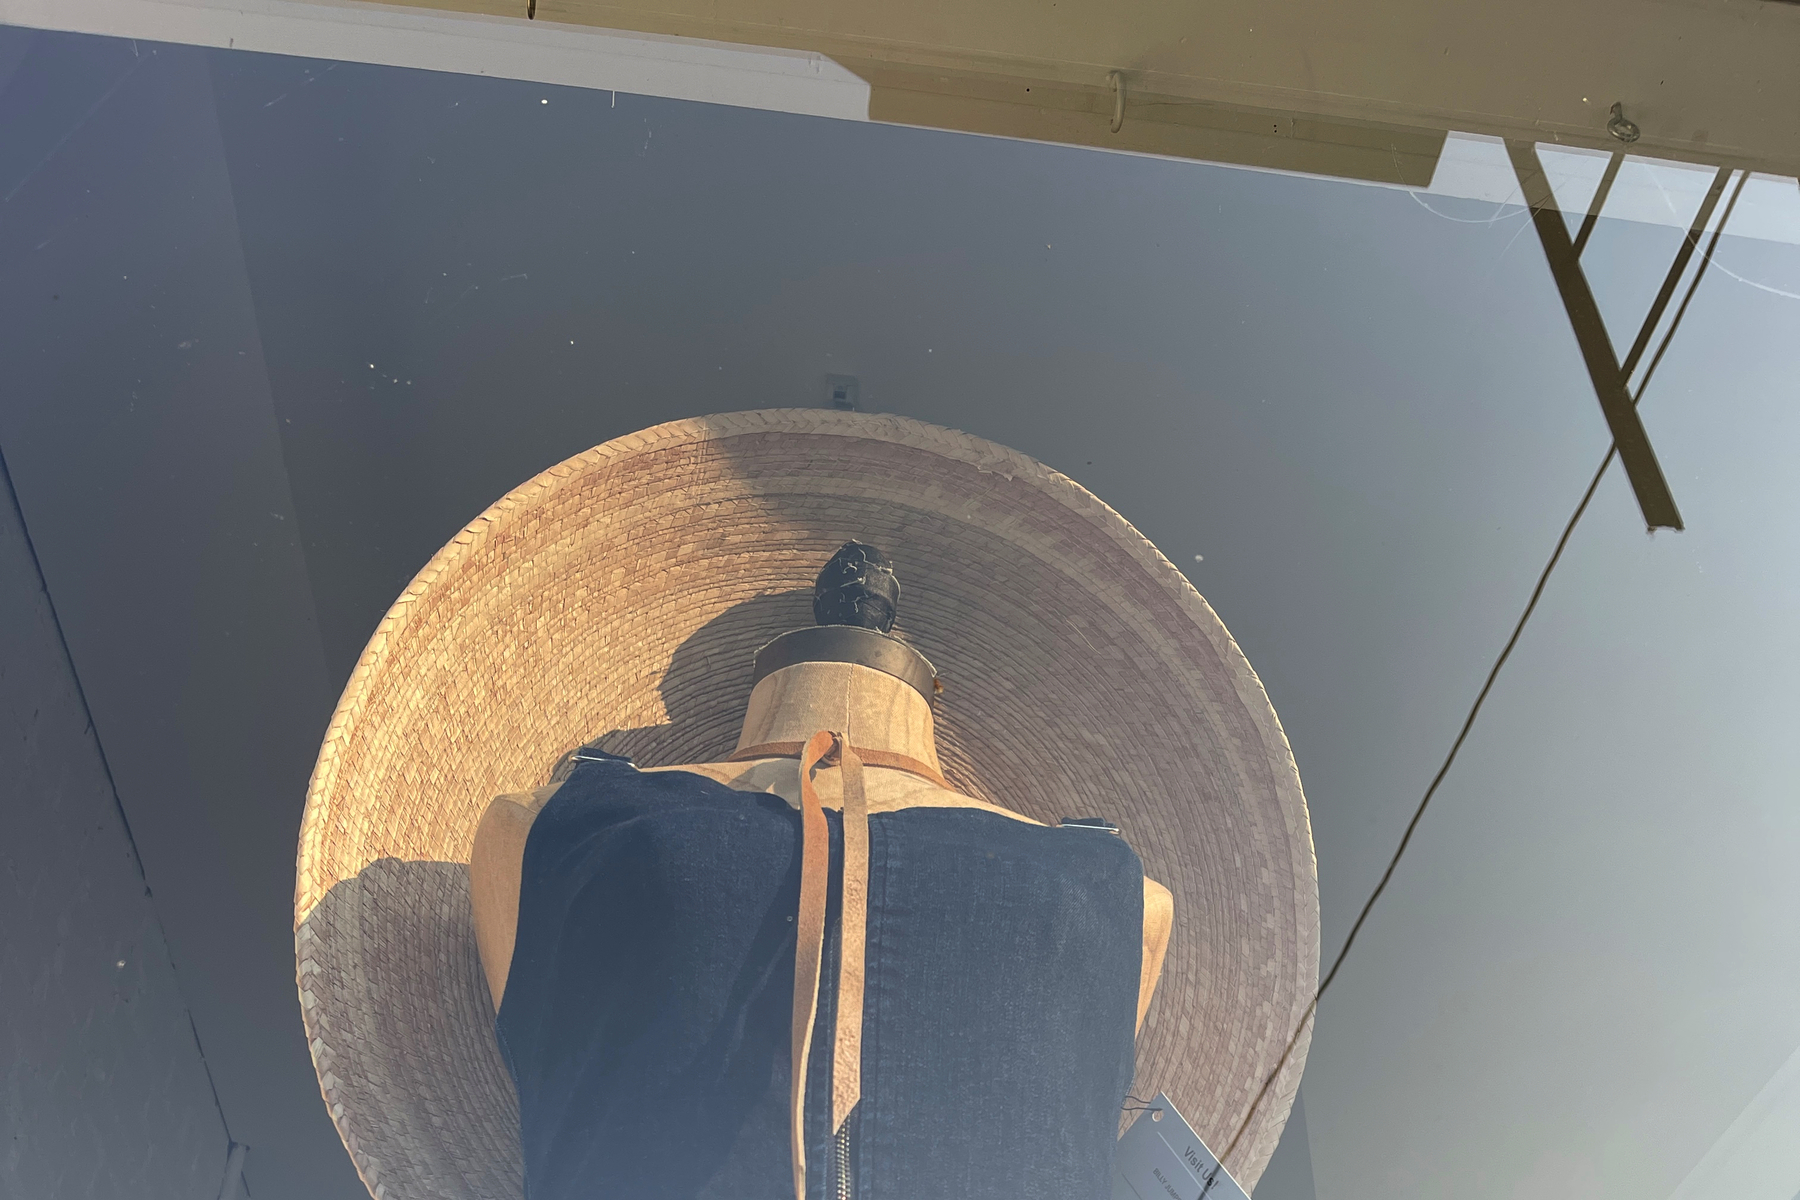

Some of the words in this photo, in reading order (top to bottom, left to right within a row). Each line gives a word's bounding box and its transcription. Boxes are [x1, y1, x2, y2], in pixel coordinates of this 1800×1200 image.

[1152, 1167, 1168, 1185] BILLY
[1184, 1146, 1204, 1173] Visit
[1202, 1168, 1219, 1190] Us!
